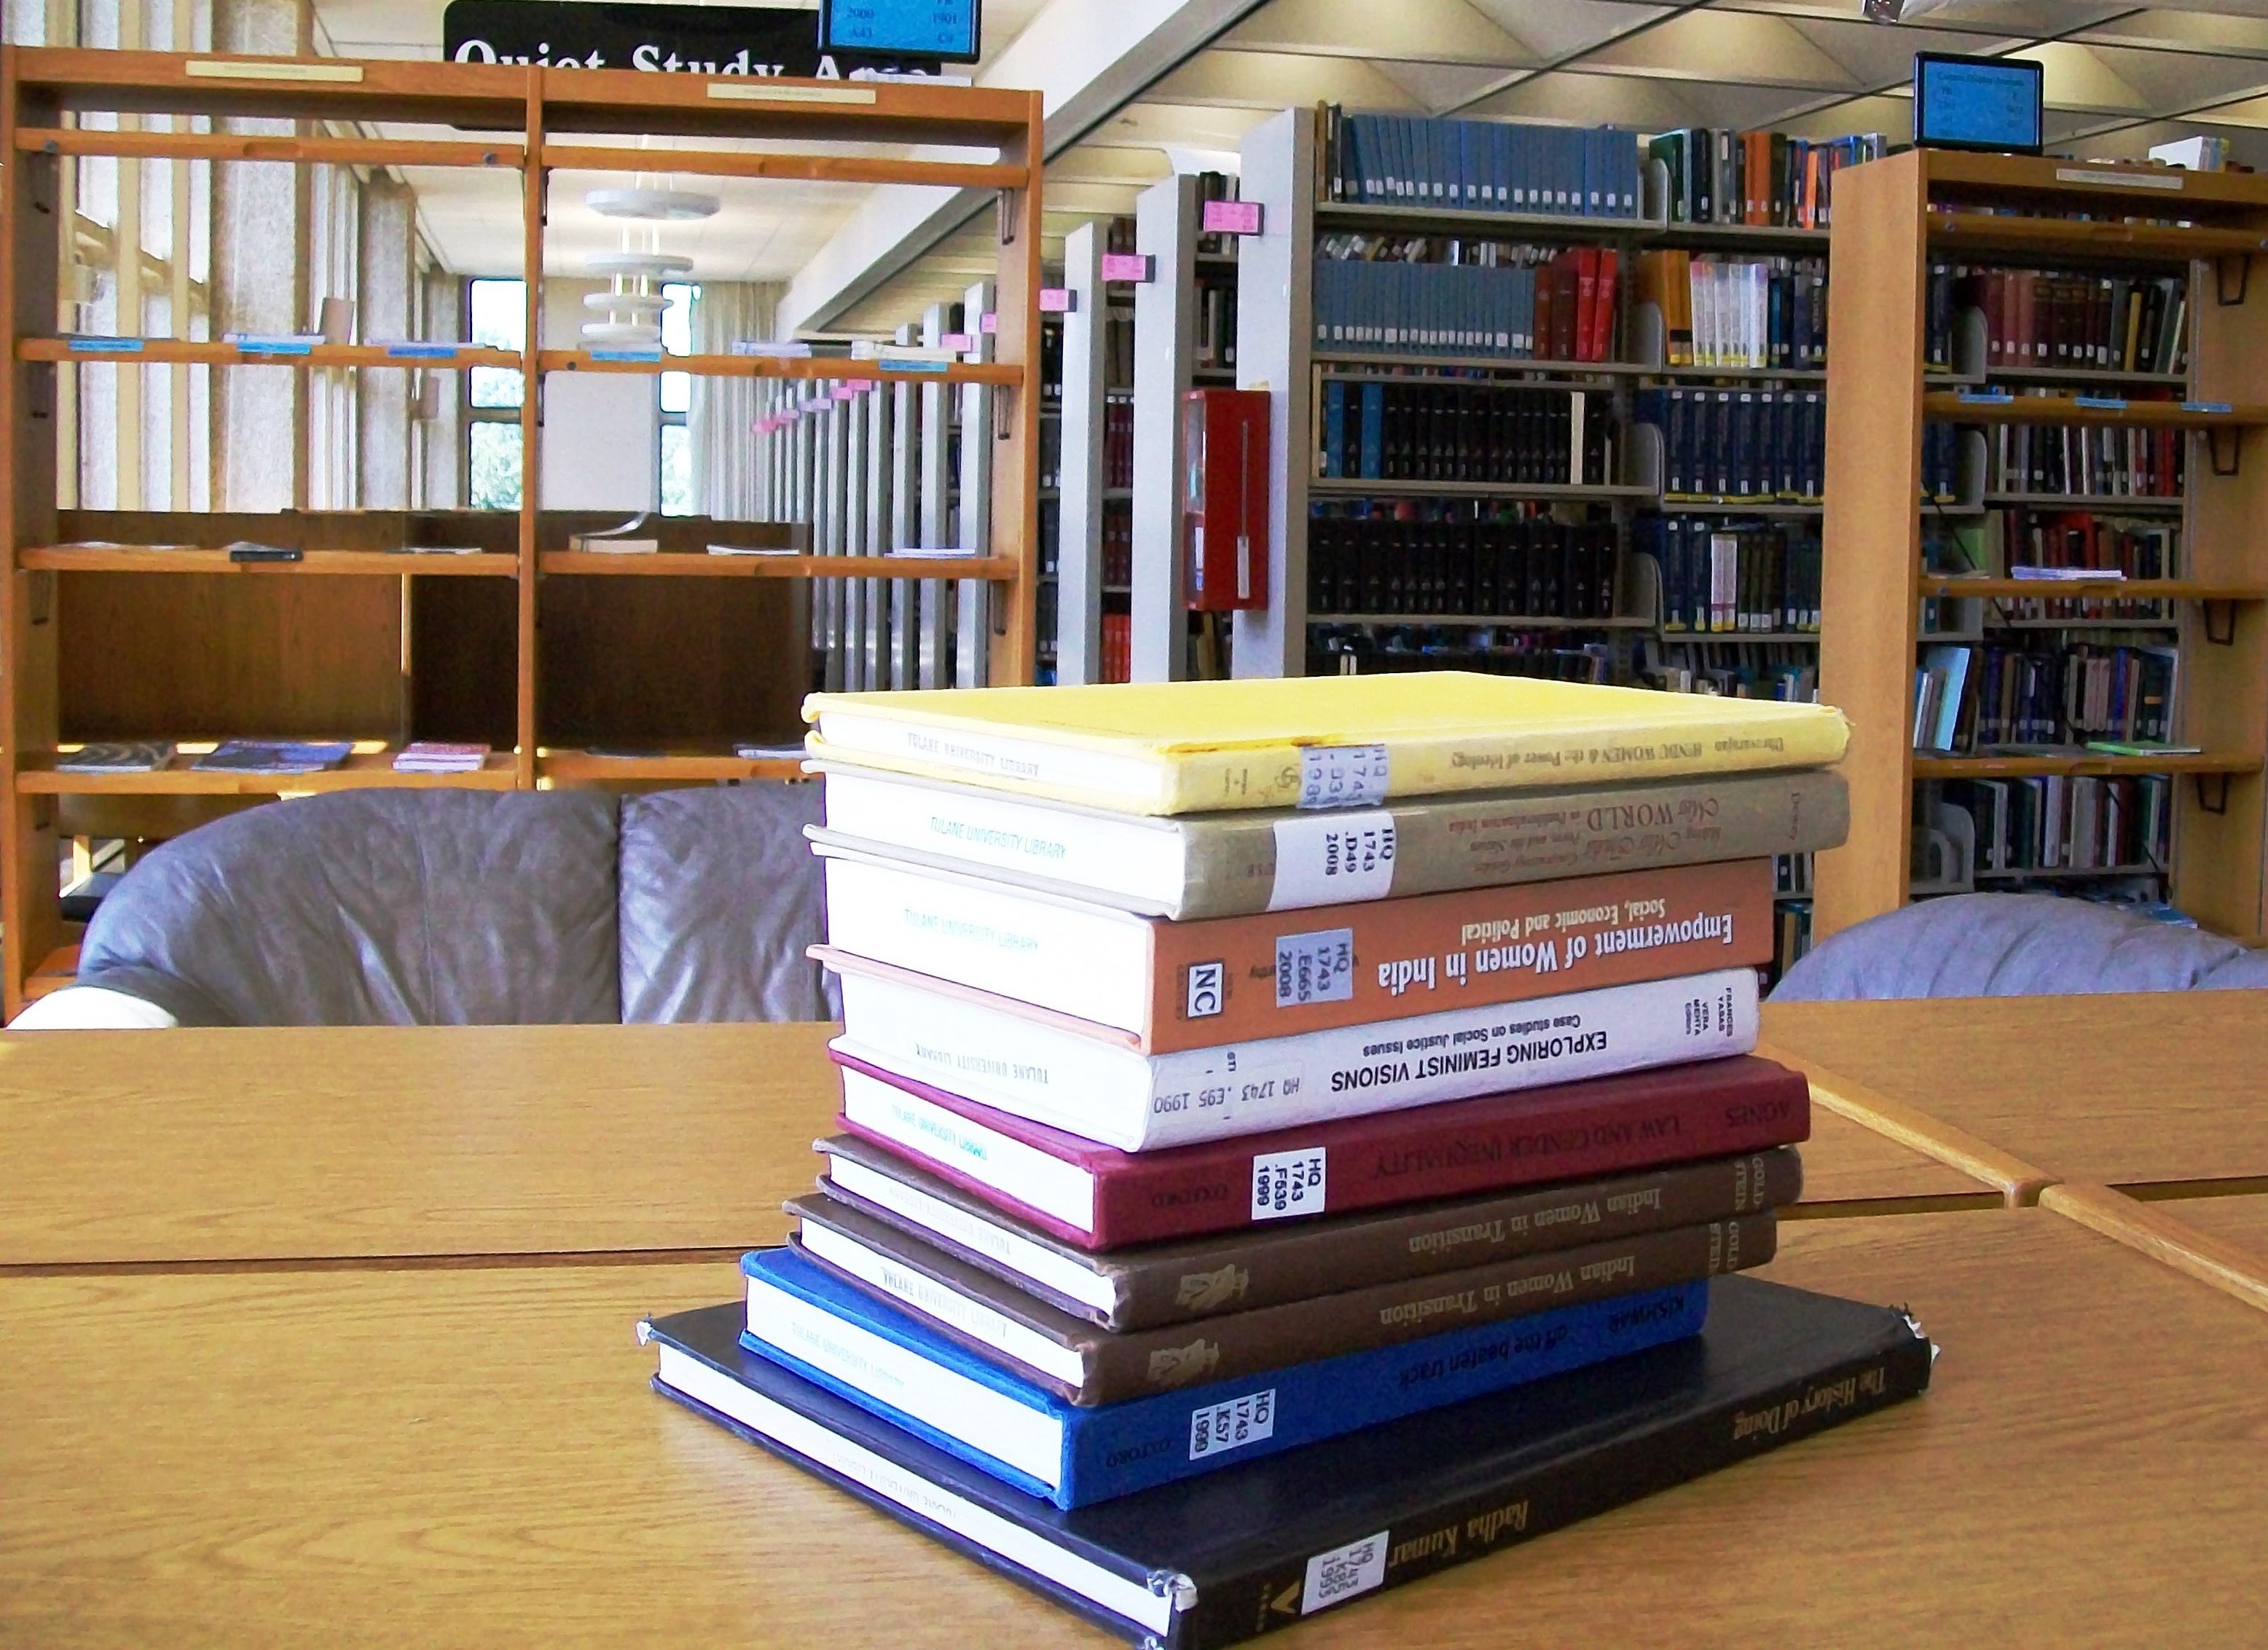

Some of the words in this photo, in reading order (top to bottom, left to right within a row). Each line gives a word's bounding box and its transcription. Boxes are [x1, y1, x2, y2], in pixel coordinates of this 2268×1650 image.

[1601, 746, 1657, 764] WOMEN
[1586, 803, 1674, 833] WORLD
[930, 816, 965, 838] TULANE
[967, 825, 1022, 851] UNIVERSITY
[1024, 837, 1067, 860] LIBRARY
[1344, 831, 1358, 874] .D49
[1362, 831, 1377, 873] 1743
[1379, 828, 1394, 861] HQ
[1325, 833, 1340, 876] 2008
[1555, 903, 1619, 933] Economic
[1624, 897, 1667, 922] Social,
[1461, 919, 1520, 947] Political
[1525, 914, 1551, 938] and
[1593, 912, 1734, 960] Empowerment
[1333, 942, 1350, 974] HQ
[1474, 947, 1560, 976] Women
[1563, 935, 1588, 970] of
[1279, 950, 1293, 999] 2008
[1298, 948, 1313, 1002] .E665
[1317, 946, 1332, 992] 1743
[1377, 958, 1437, 997] India
[1445, 952, 1469, 987] in
[1194, 968, 1217, 1013] NC
[1453, 1028, 1489, 1048] Social
[1491, 1025, 1507, 1037] on
[1509, 1018, 1551, 1037] studies
[1552, 1016, 1582, 1029] Case
[1362, 1041, 1404, 1058] Issues
[1405, 1033, 1451, 1056] Justice
[1506, 1030, 1609, 1064] EXPLORING
[1331, 1064, 1410, 1093] VISIONS
[1415, 1048, 1502, 1079] FEMINIST
[1198, 1086, 1232, 1107] .E95
[1241, 1080, 1276, 1101] 1743
[1283, 1077, 1300, 1096] HQ
[1154, 1092, 1191, 1114] 1990
[1257, 1165, 1271, 1206] 1999
[1291, 1160, 1305, 1202] 1743
[1307, 1158, 1322, 1187] HQ
[1534, 1201, 1601, 1227] Women
[1607, 1187, 1661, 1216] Indian
[1408, 1221, 1506, 1255] Transition
[1510, 1215, 1529, 1235] in
[1507, 1271, 1575, 1297] Women
[1580, 1254, 1635, 1285] Indian
[1378, 1290, 1475, 1326] Transition
[1483, 1286, 1502, 1307] in
[1398, 1359, 1447, 1391] track
[1858, 1367, 1886, 1396] The
[1253, 1392, 1271, 1425] HQ
[1799, 1377, 1857, 1416] History
[1235, 1400, 1251, 1441] 1743
[1733, 1405, 1781, 1442] Doing
[1781, 1399, 1800, 1431] of
[1467, 1499, 1529, 1544] Radha
[1387, 1525, 1459, 1570] Kumar
